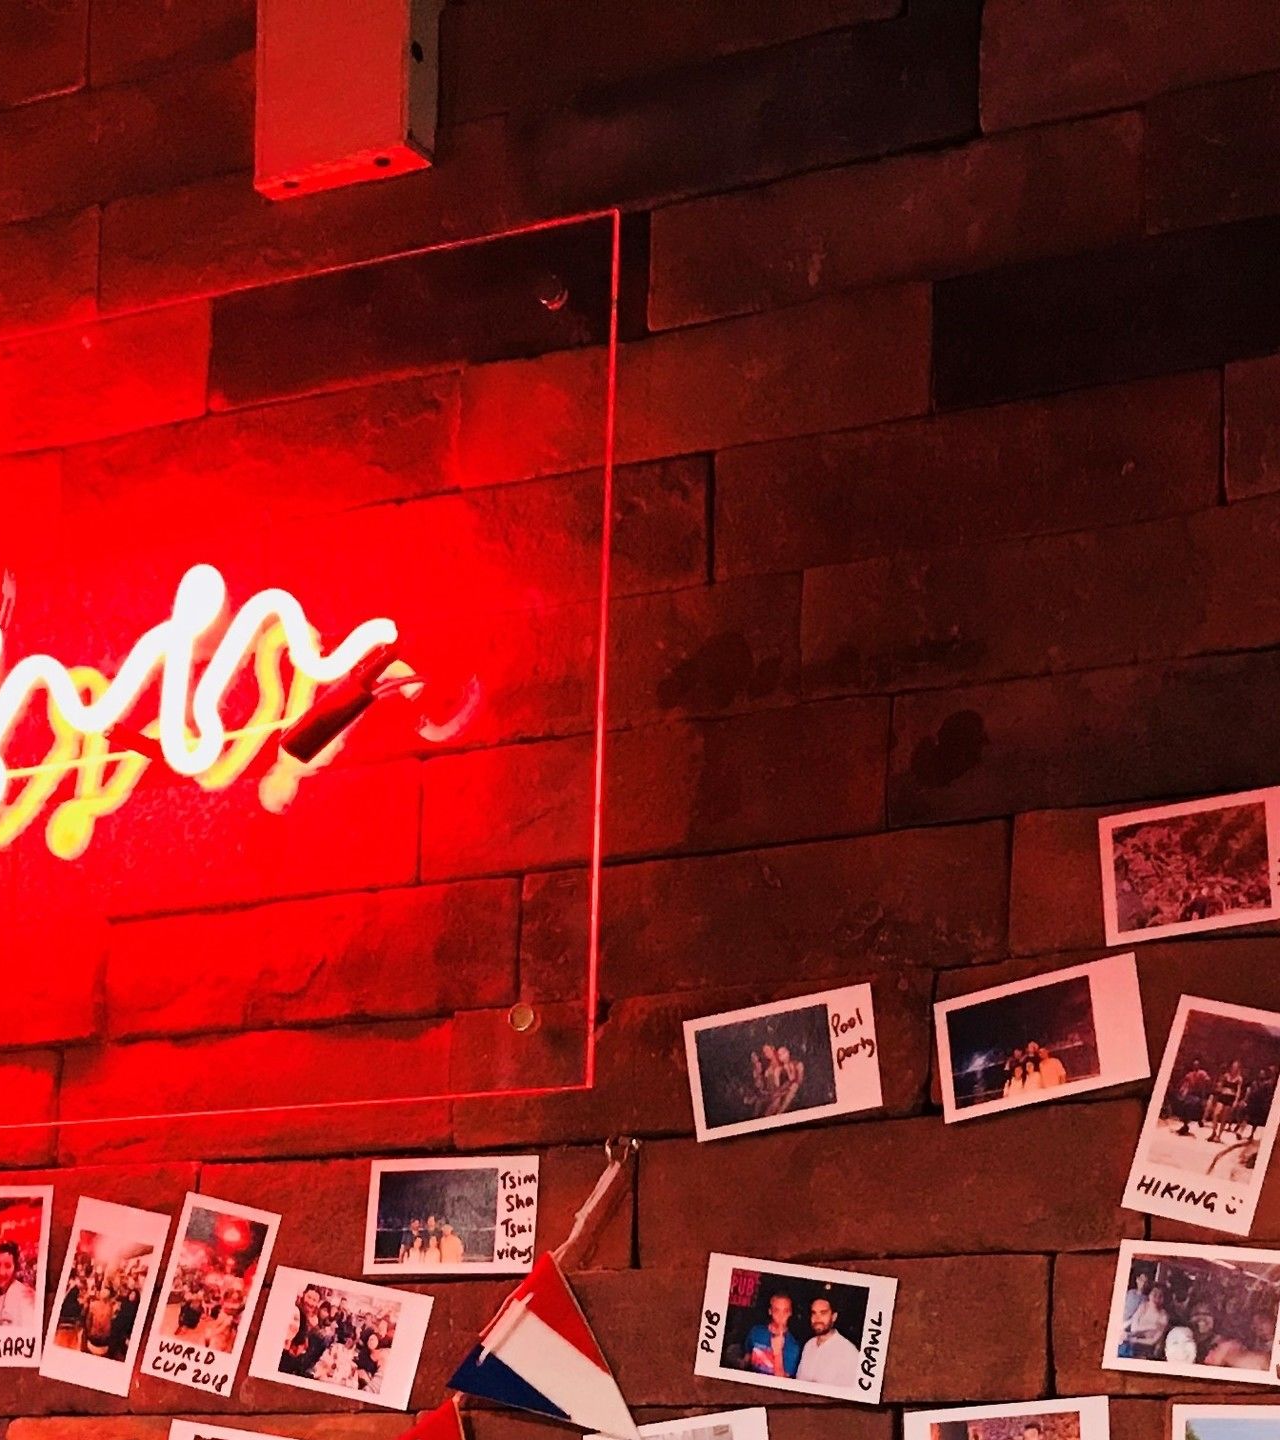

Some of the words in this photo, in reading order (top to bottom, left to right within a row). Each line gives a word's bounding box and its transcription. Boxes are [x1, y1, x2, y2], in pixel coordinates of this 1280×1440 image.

[830, 1012, 864, 1039] Pool
[834, 1036, 876, 1070] party
[500, 1170, 538, 1190] Tsim
[1136, 1174, 1219, 1213] HIKING
[505, 1194, 535, 1210] Sha
[158, 1341, 216, 1366] WORLD
[700, 1310, 722, 1354] PUB
[858, 1310, 883, 1391] CRAWL
[151, 1355, 189, 1378] CUP
[191, 1368, 229, 1392] 2018
